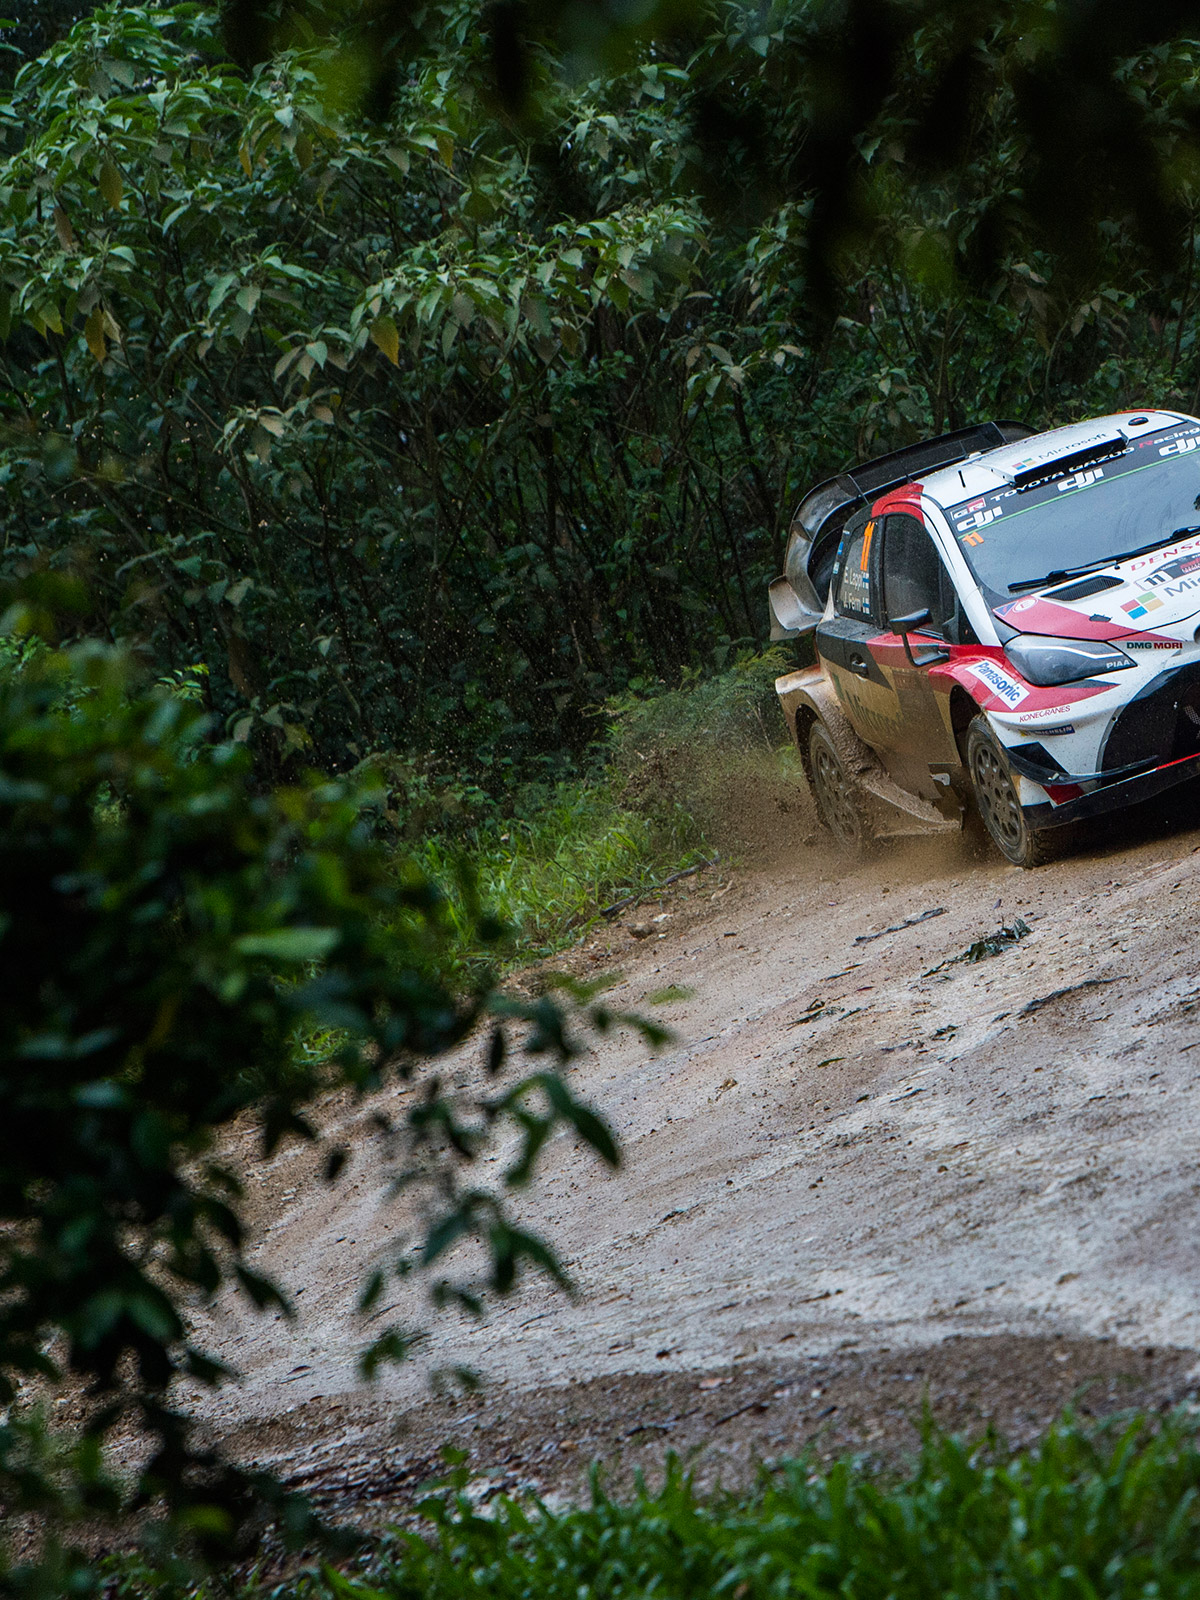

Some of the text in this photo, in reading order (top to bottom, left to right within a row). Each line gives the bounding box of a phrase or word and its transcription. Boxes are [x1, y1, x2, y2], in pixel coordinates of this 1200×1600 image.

[1038, 433, 1107, 460] Microsoft
[990, 471, 1065, 502] TOYOTA
[1138, 426, 1200, 449] Racing
[962, 531, 985, 547] 11
[1143, 573, 1166, 586] 11
[1126, 641, 1152, 650] DMG
[1106, 660, 1131, 669] PIAA
[973, 661, 1021, 702] Panasonic
[1019, 705, 1071, 723] KONECRANES
